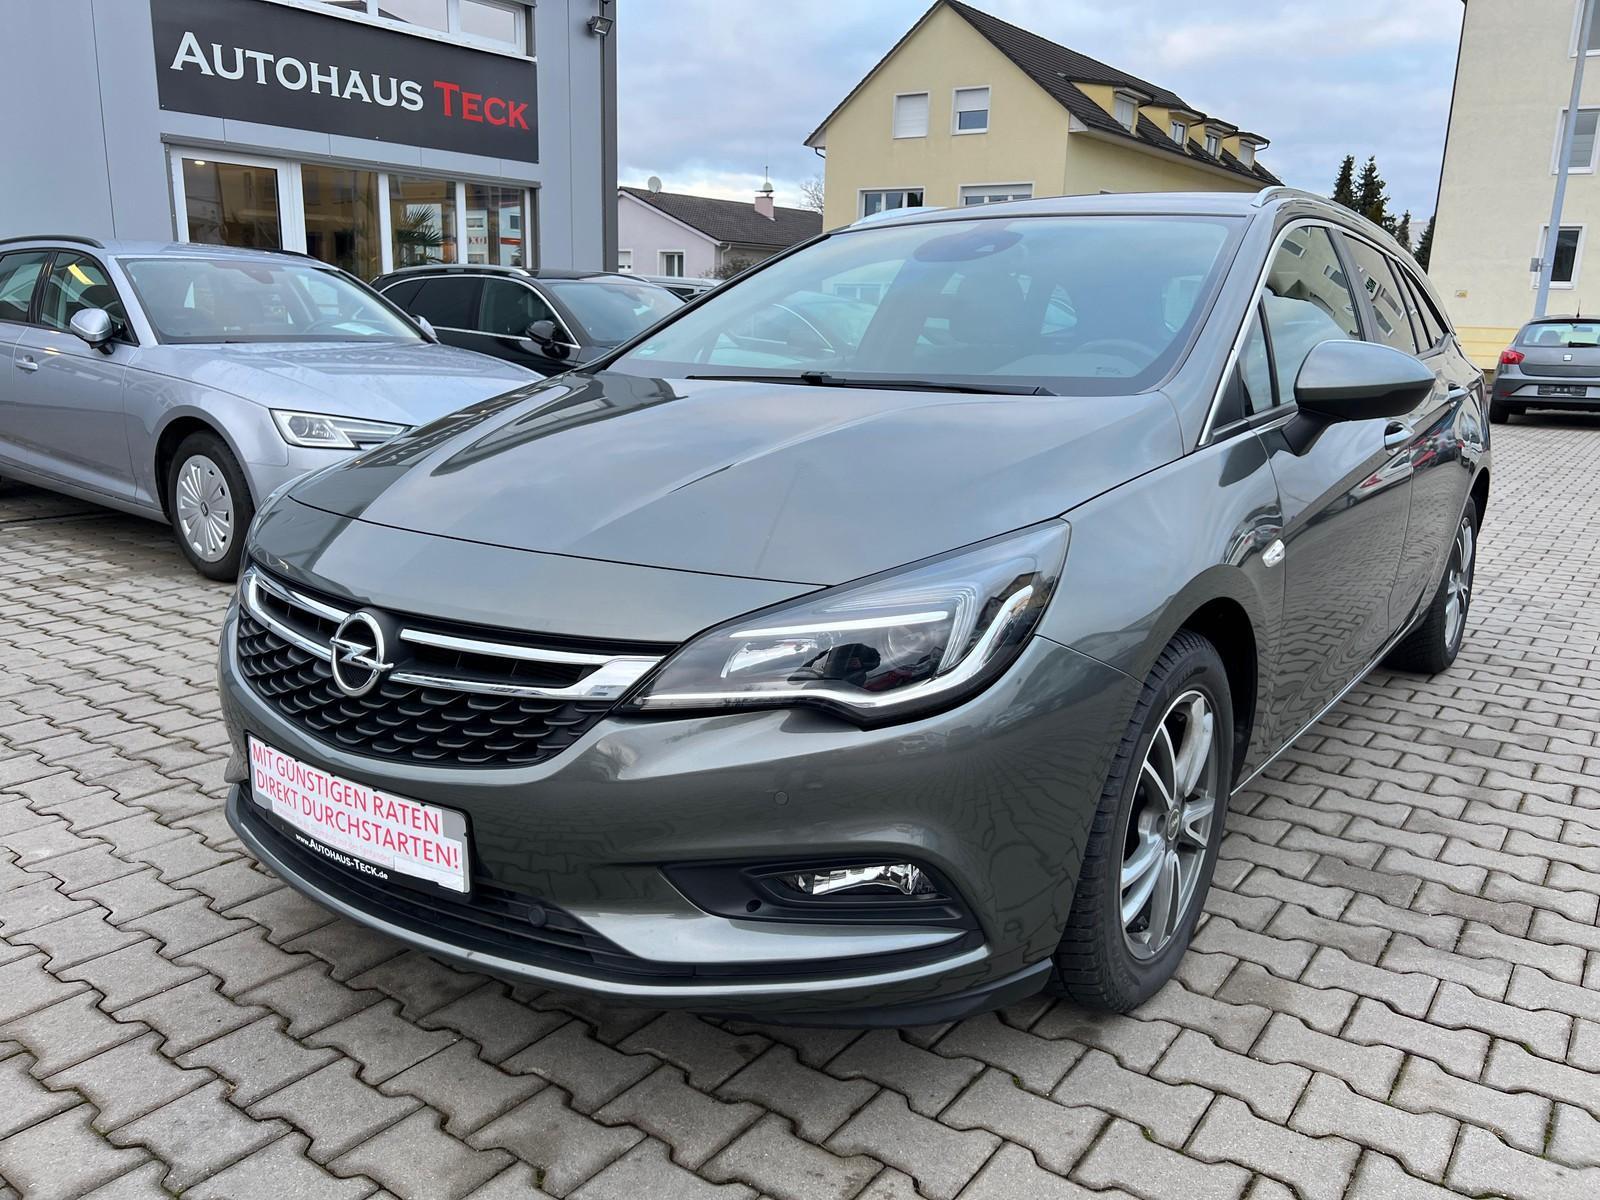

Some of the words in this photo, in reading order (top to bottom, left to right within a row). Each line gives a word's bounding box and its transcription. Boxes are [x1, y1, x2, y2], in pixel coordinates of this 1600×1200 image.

[170, 31, 424, 112] AUTOHAUS
[433, 80, 530, 130] TECK
[252, 743, 273, 770] MIT
[276, 756, 367, 812] GÜNSTIGEN
[373, 795, 440, 835] RATEN
[256, 768, 299, 807] DIREKT
[302, 795, 459, 870] DURCHSTARTEN!
